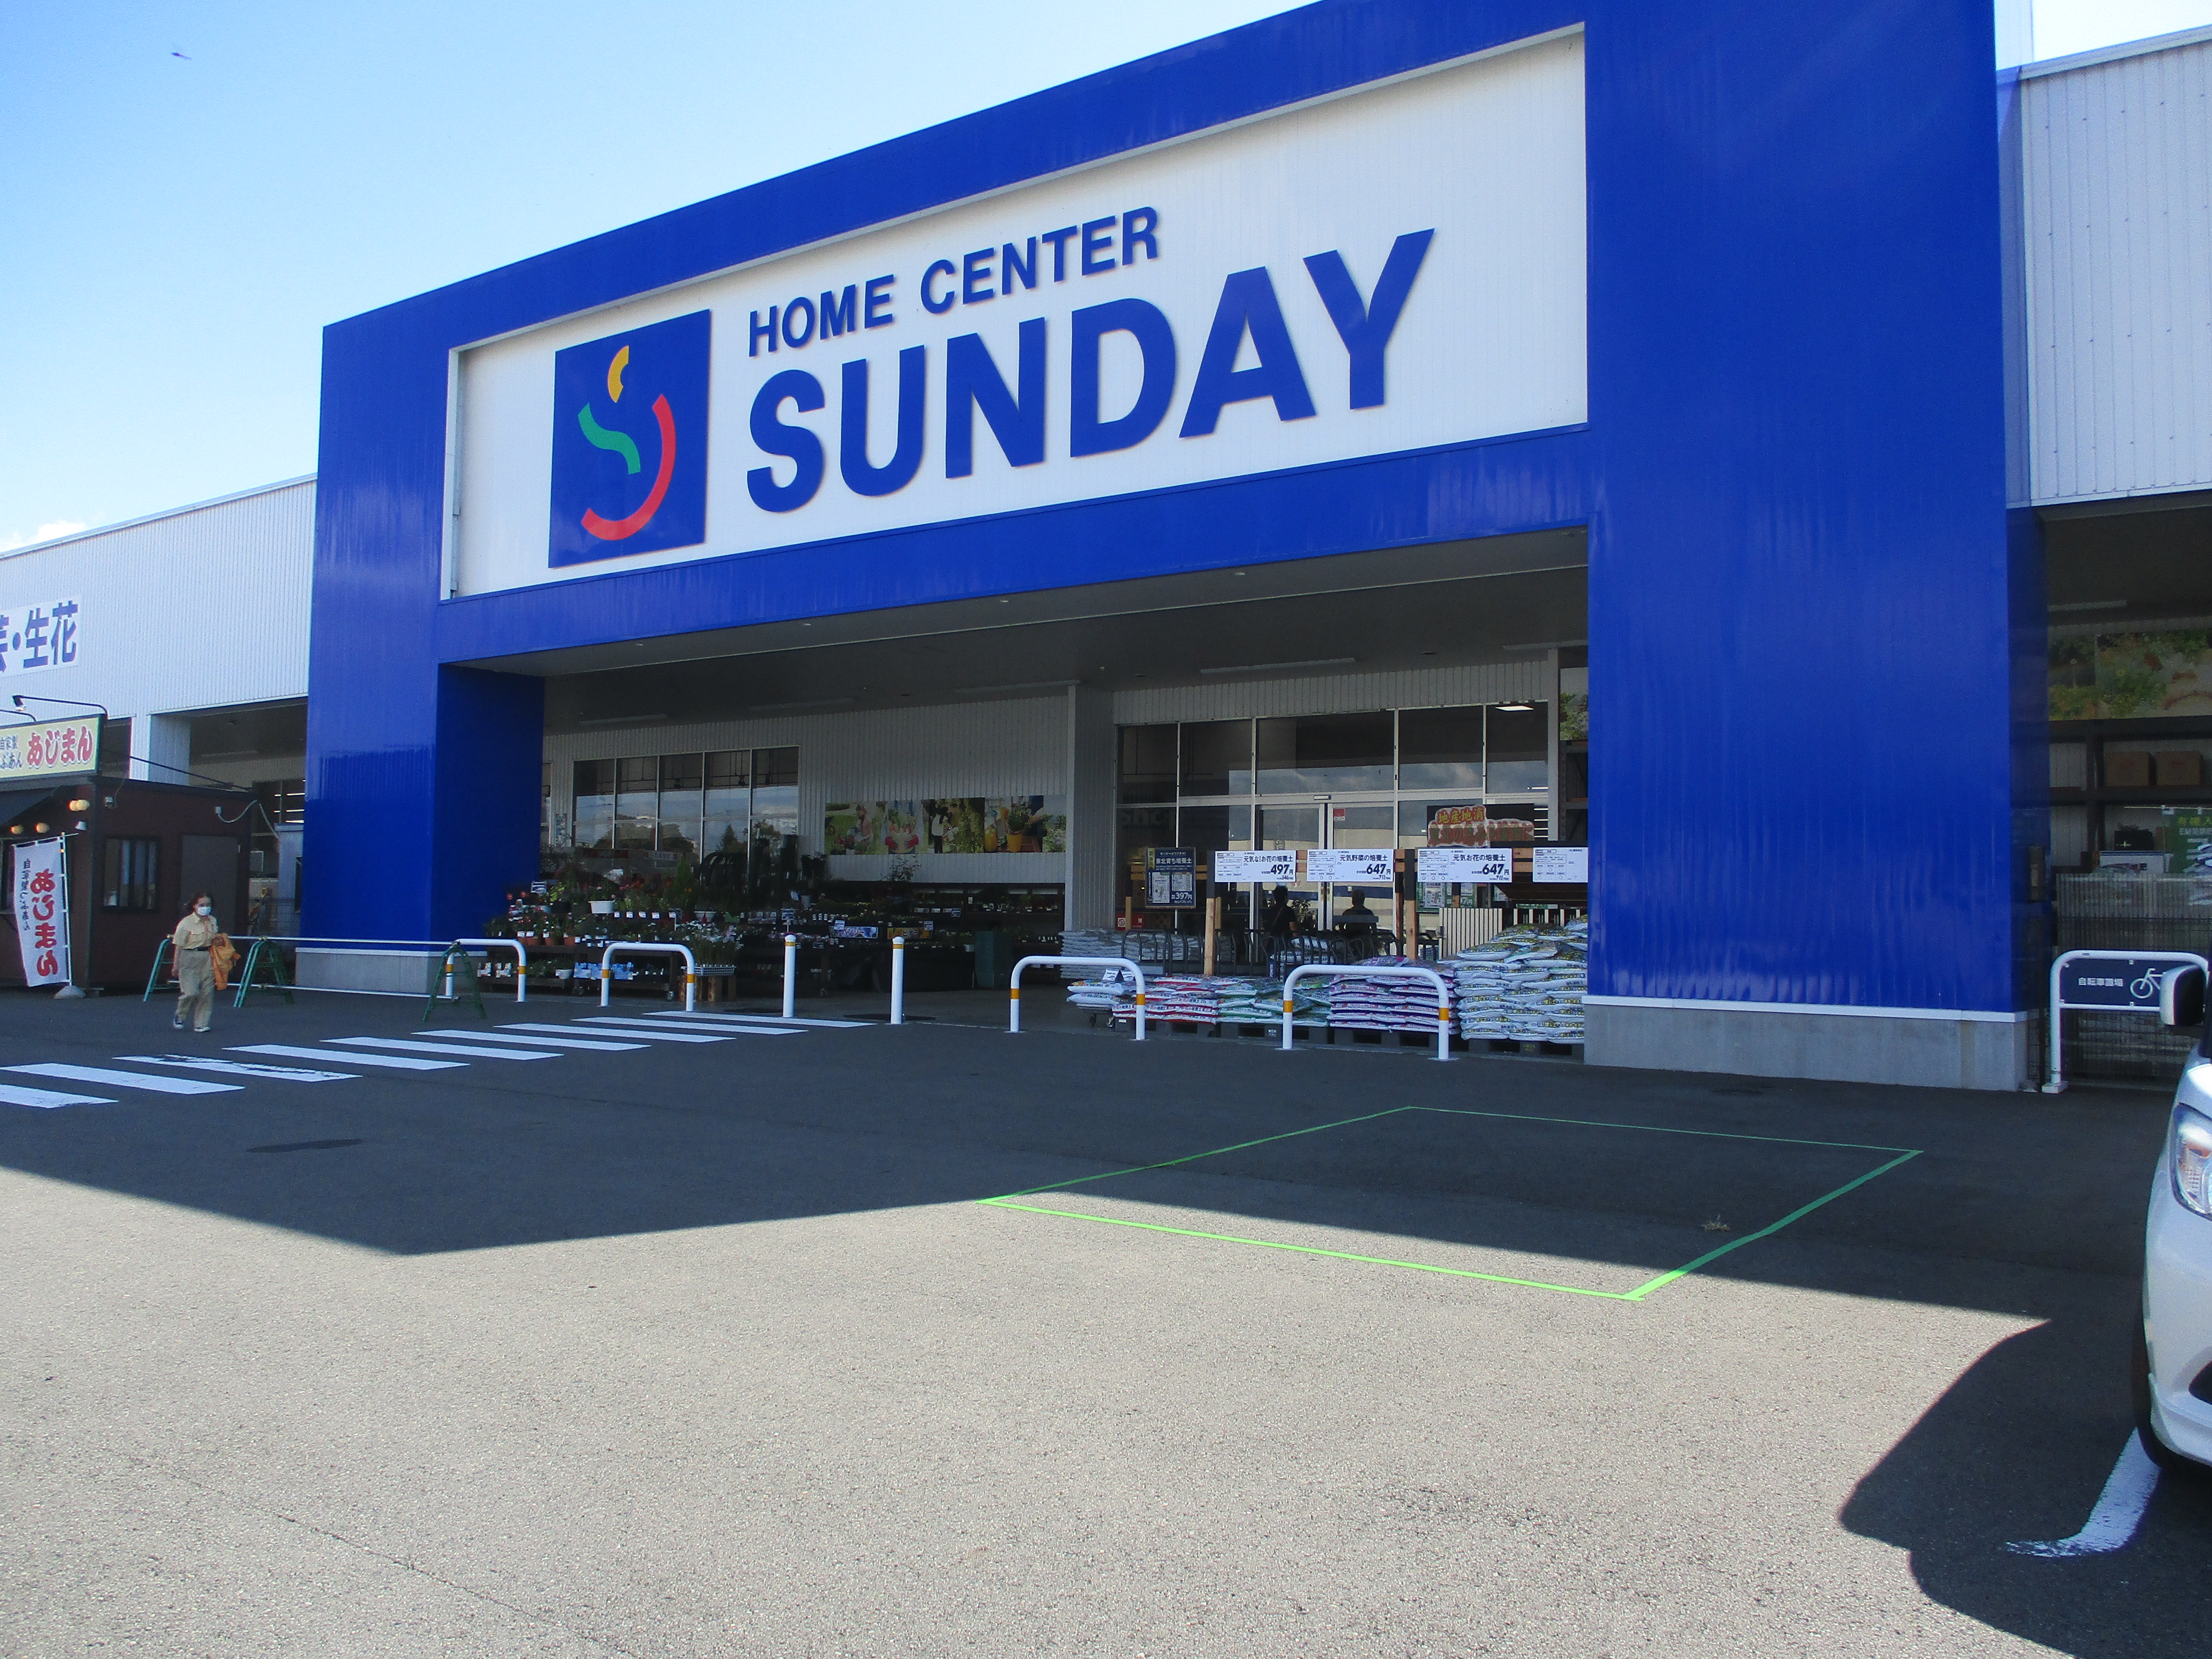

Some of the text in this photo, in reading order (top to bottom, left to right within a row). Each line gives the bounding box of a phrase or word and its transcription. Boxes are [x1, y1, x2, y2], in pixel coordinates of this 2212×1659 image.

[748, 206, 1159, 358] HOME CENTER
[746, 228, 1436, 514] SUNDAY
[27, 725, 94, 769] あじまん
[1438, 807, 1484, 824] 地産地消
